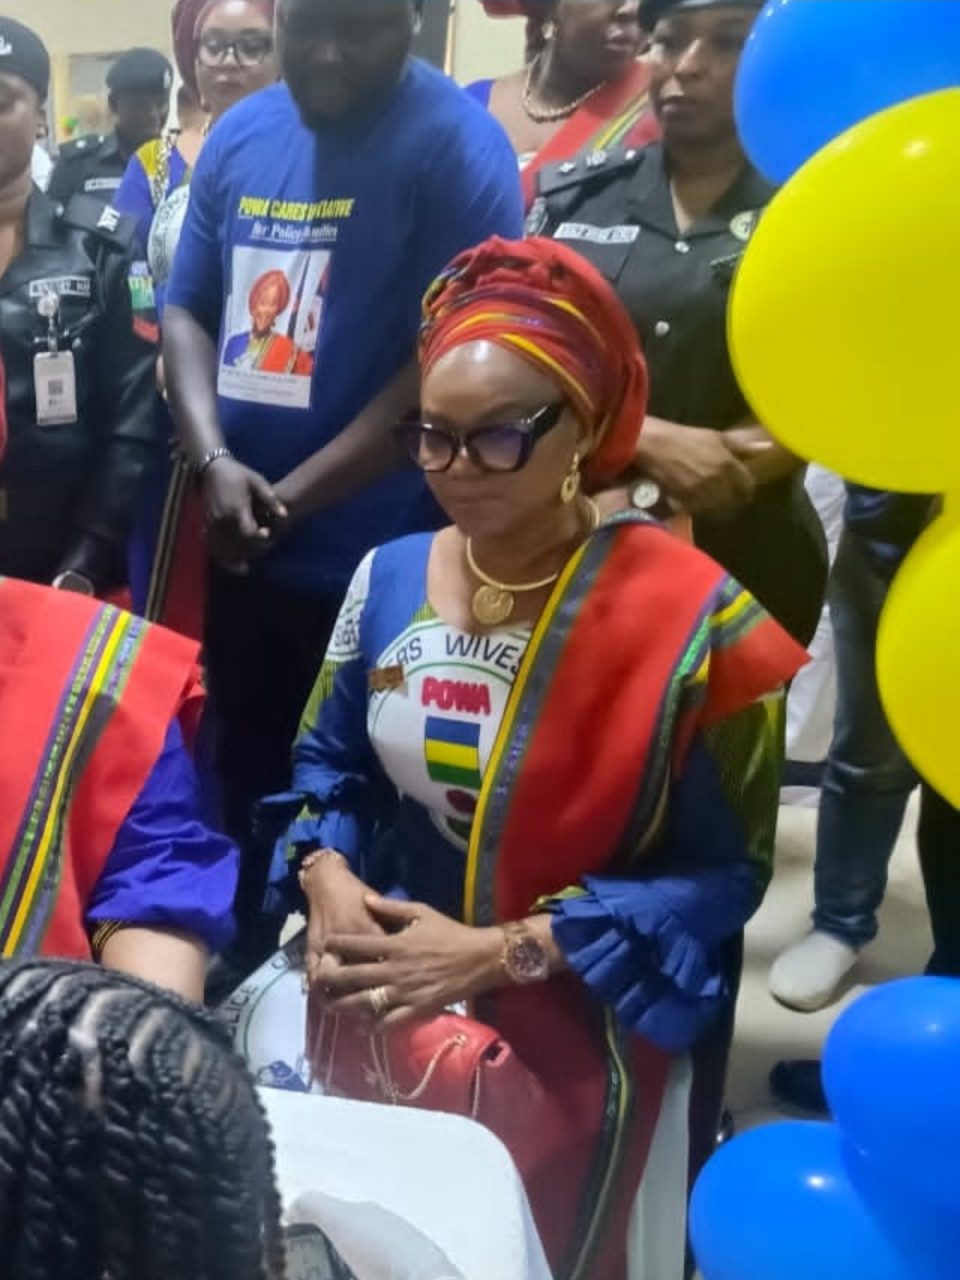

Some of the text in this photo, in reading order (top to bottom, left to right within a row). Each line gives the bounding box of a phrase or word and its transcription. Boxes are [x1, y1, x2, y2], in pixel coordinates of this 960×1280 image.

[239, 195, 271, 217] POWA
[270, 199, 309, 221] CARES
[420, 675, 492, 717] POWA
